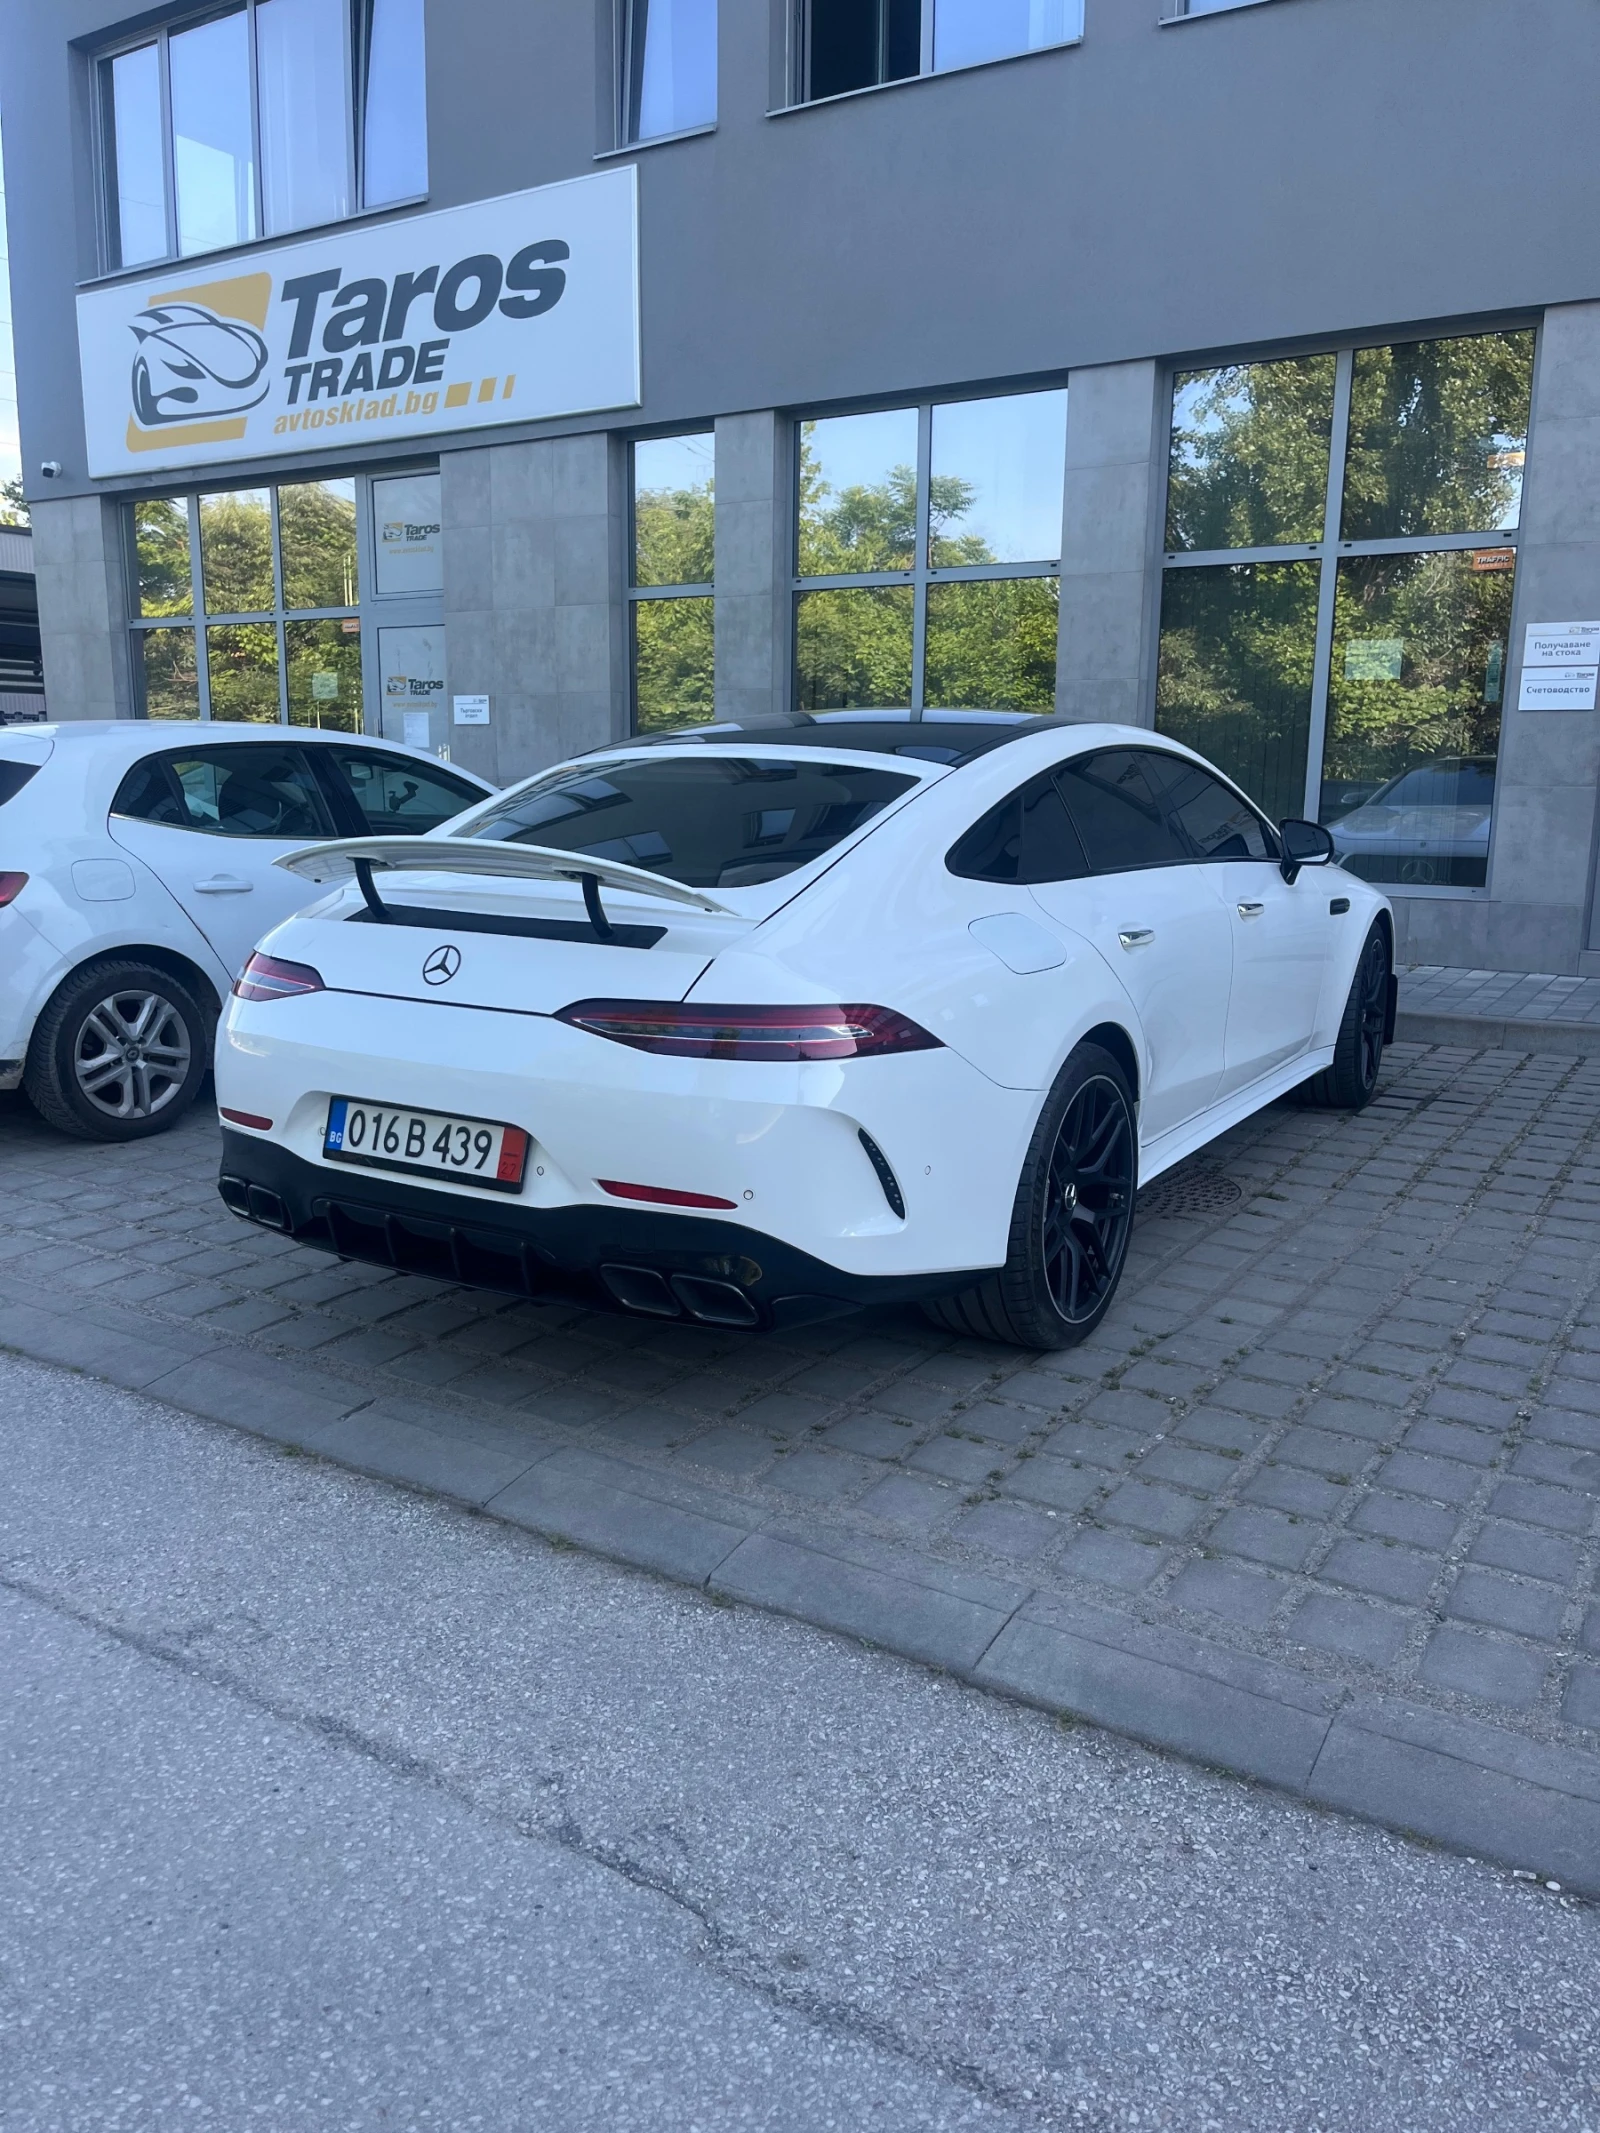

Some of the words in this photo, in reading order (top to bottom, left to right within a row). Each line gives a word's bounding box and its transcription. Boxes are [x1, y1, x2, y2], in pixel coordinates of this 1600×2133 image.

[281, 239, 571, 361] Taros
[284, 338, 451, 406] TRADE
[273, 391, 439, 435] avtosklad.bg
[404, 524, 441, 536] Taros
[1476, 555, 1511, 564] TRAFFIC
[1534, 642, 1592, 651] Получаване
[1555, 649, 1582, 657] стока
[408, 679, 444, 690] Taros
[1526, 686, 1591, 694] Счетоводство
[329, 1131, 343, 1144] BG
